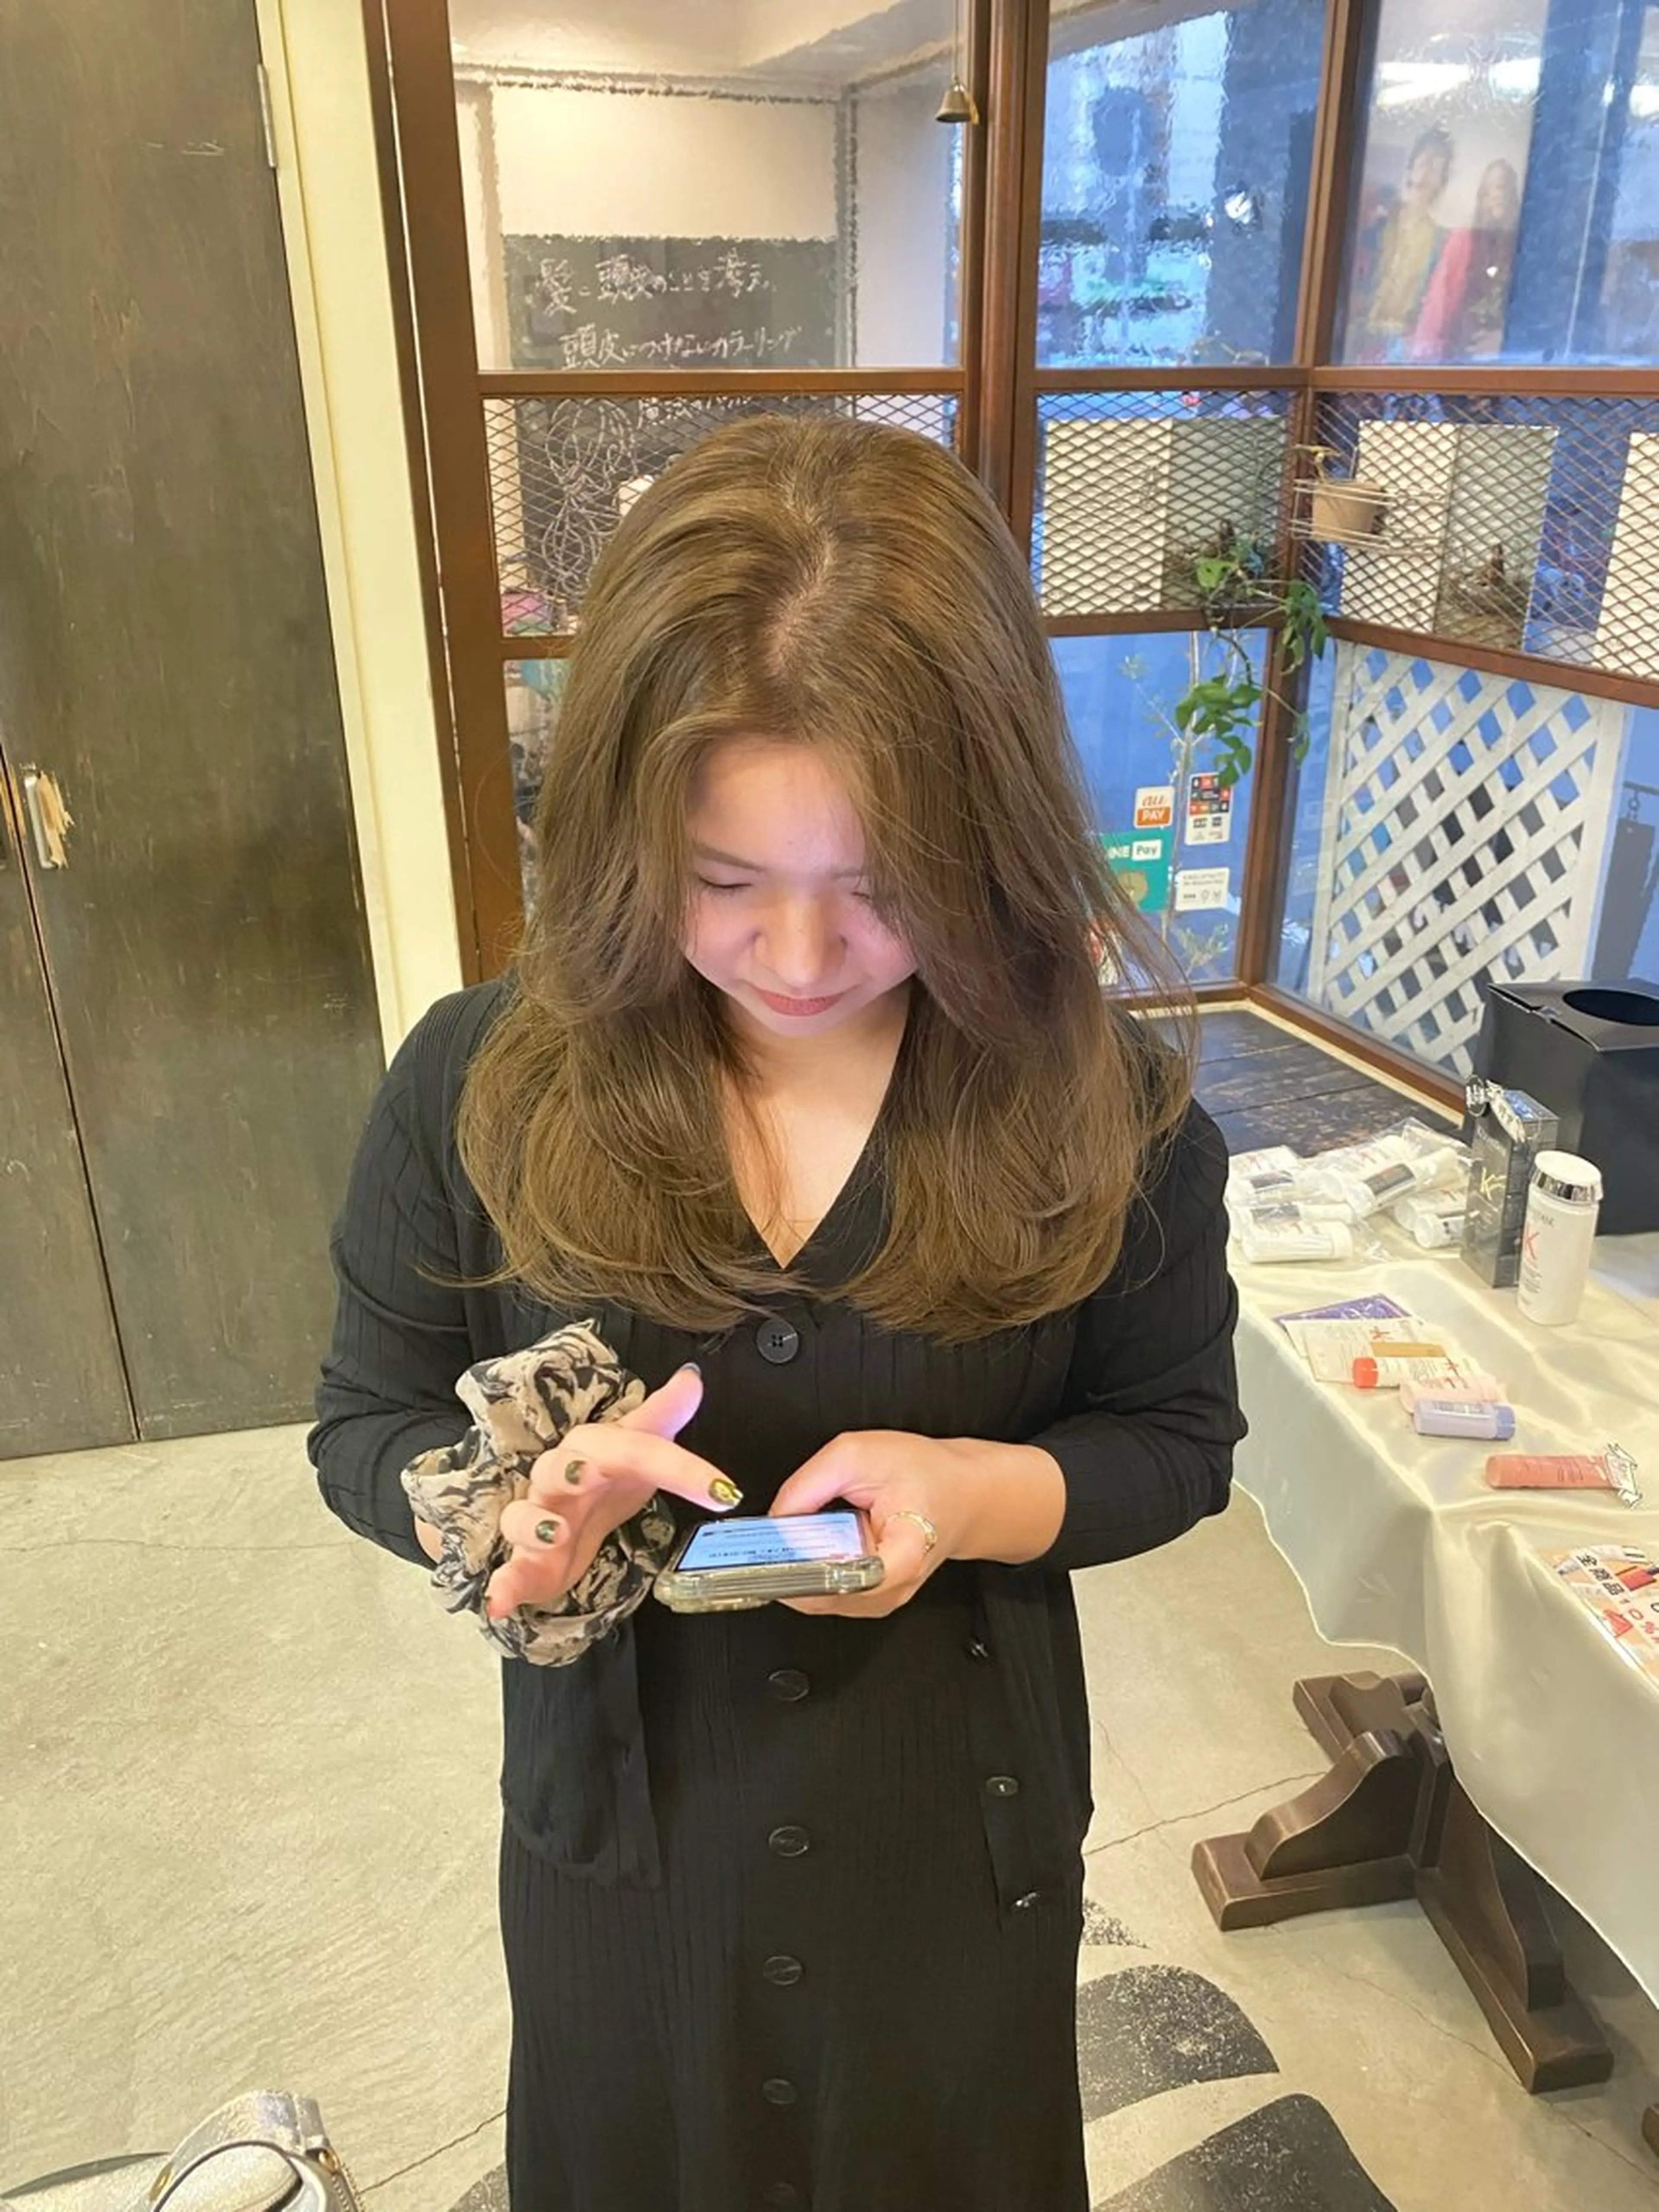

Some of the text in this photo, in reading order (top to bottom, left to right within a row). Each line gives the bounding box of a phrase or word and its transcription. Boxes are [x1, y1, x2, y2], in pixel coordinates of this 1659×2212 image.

[1142, 795, 1164, 807] au
[1142, 809, 1165, 821] PAY
[1136, 844, 1158, 855] Pay
